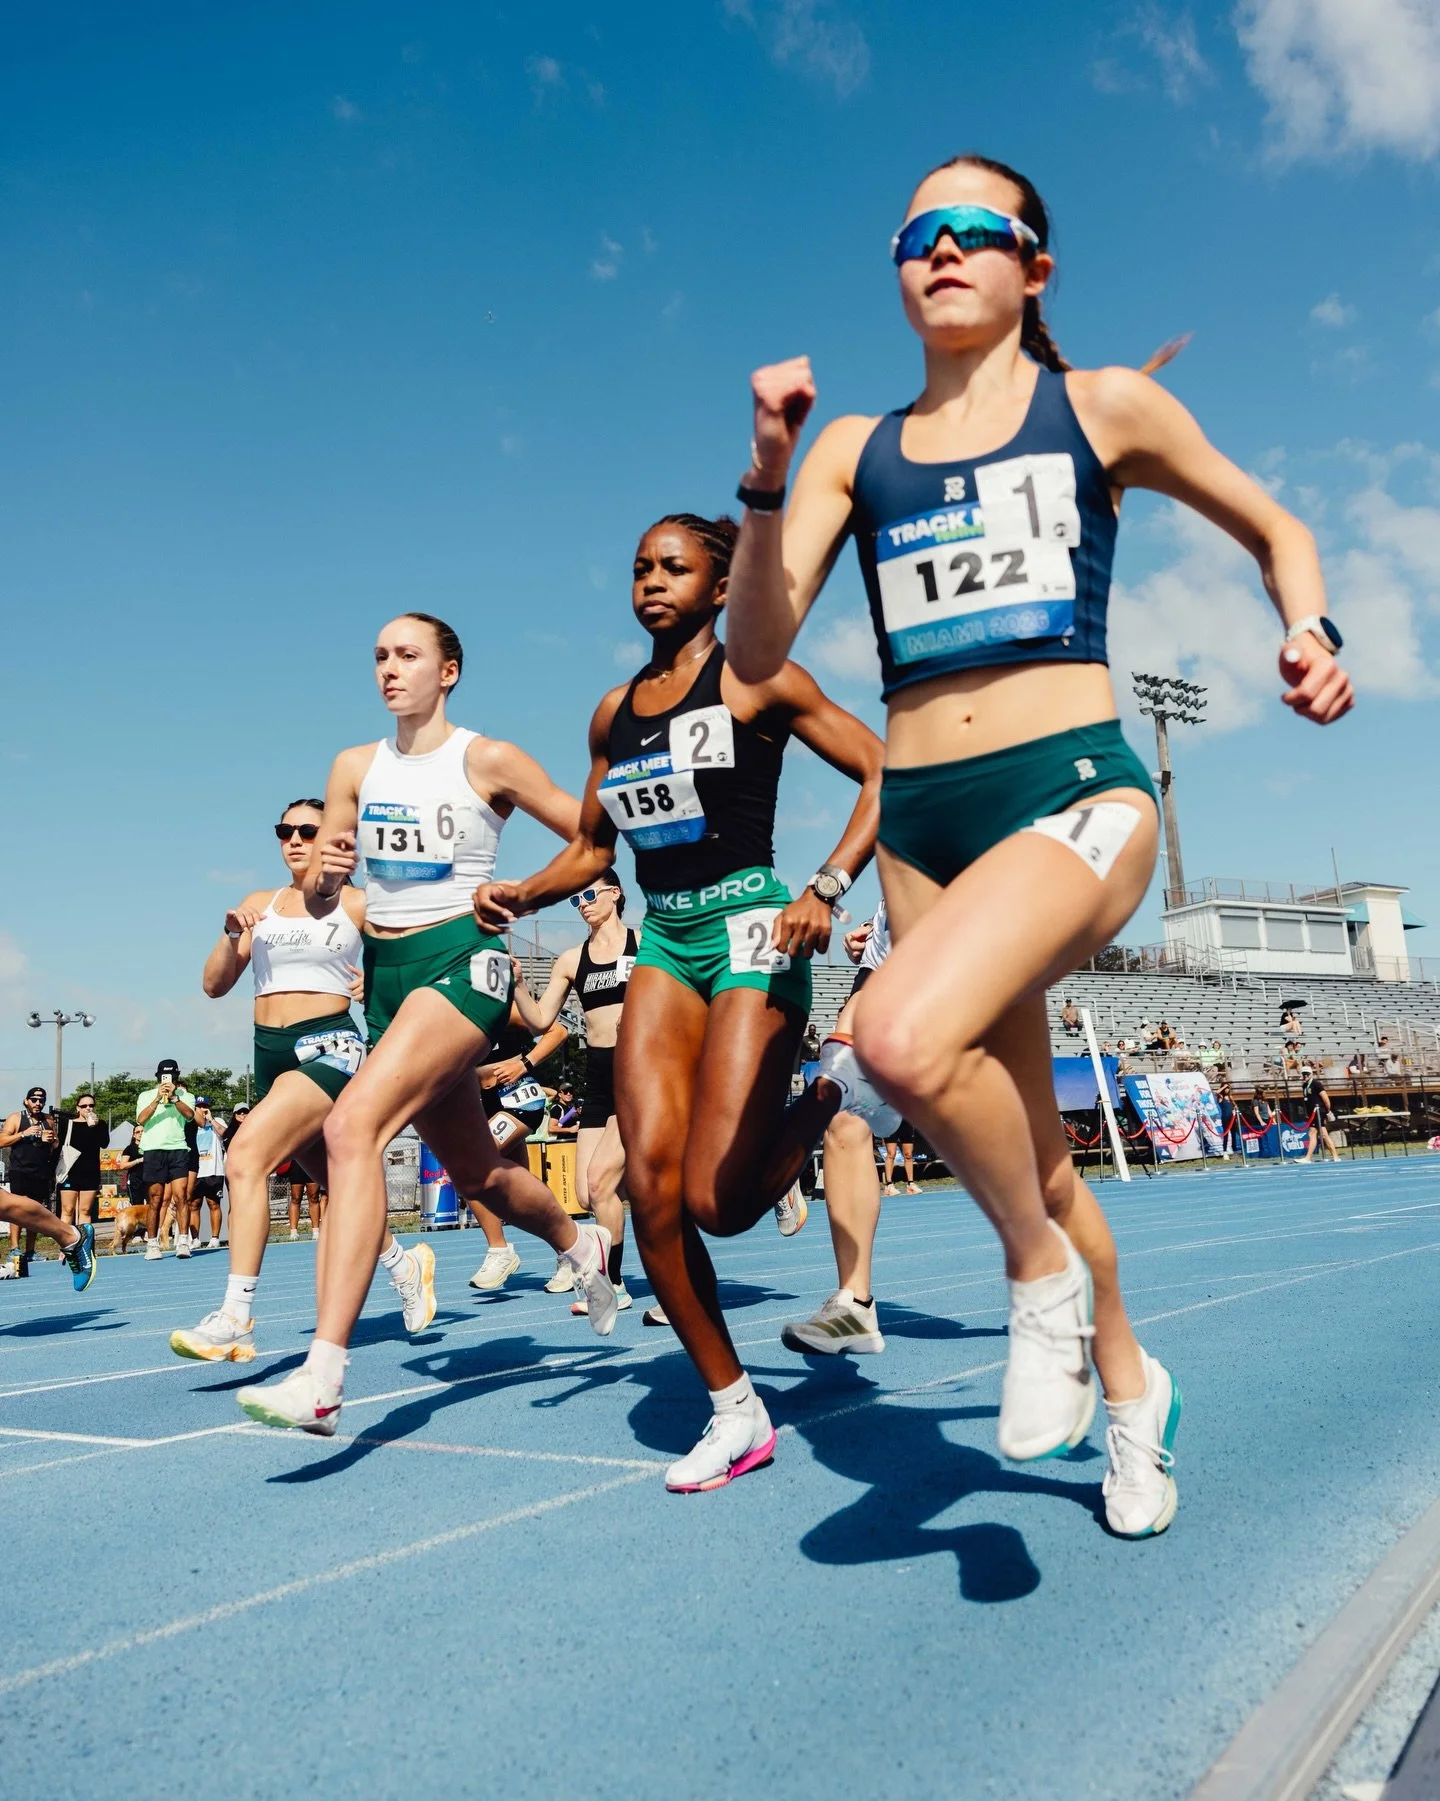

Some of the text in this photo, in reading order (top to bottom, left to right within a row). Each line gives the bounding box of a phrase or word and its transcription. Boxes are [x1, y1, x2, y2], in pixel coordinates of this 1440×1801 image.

[1012, 473, 1041, 539] 1
[888, 510, 967, 546] TRACK
[915, 551, 1029, 603] 122
[689, 721, 712, 764] 2
[608, 760, 640, 780] TRACK
[369, 805, 404, 816] TRACK
[617, 783, 675, 818] 158
[437, 803, 454, 840] 6
[376, 827, 425, 852] 131
[646, 872, 766, 911] NIKE PRO
[325, 922, 340, 946] 7
[747, 922, 770, 966] 2
[486, 956, 499, 993] 6
[302, 1032, 335, 1045] TRACK
[512, 1085, 539, 1103] 110
[493, 1120, 508, 1136] 9
